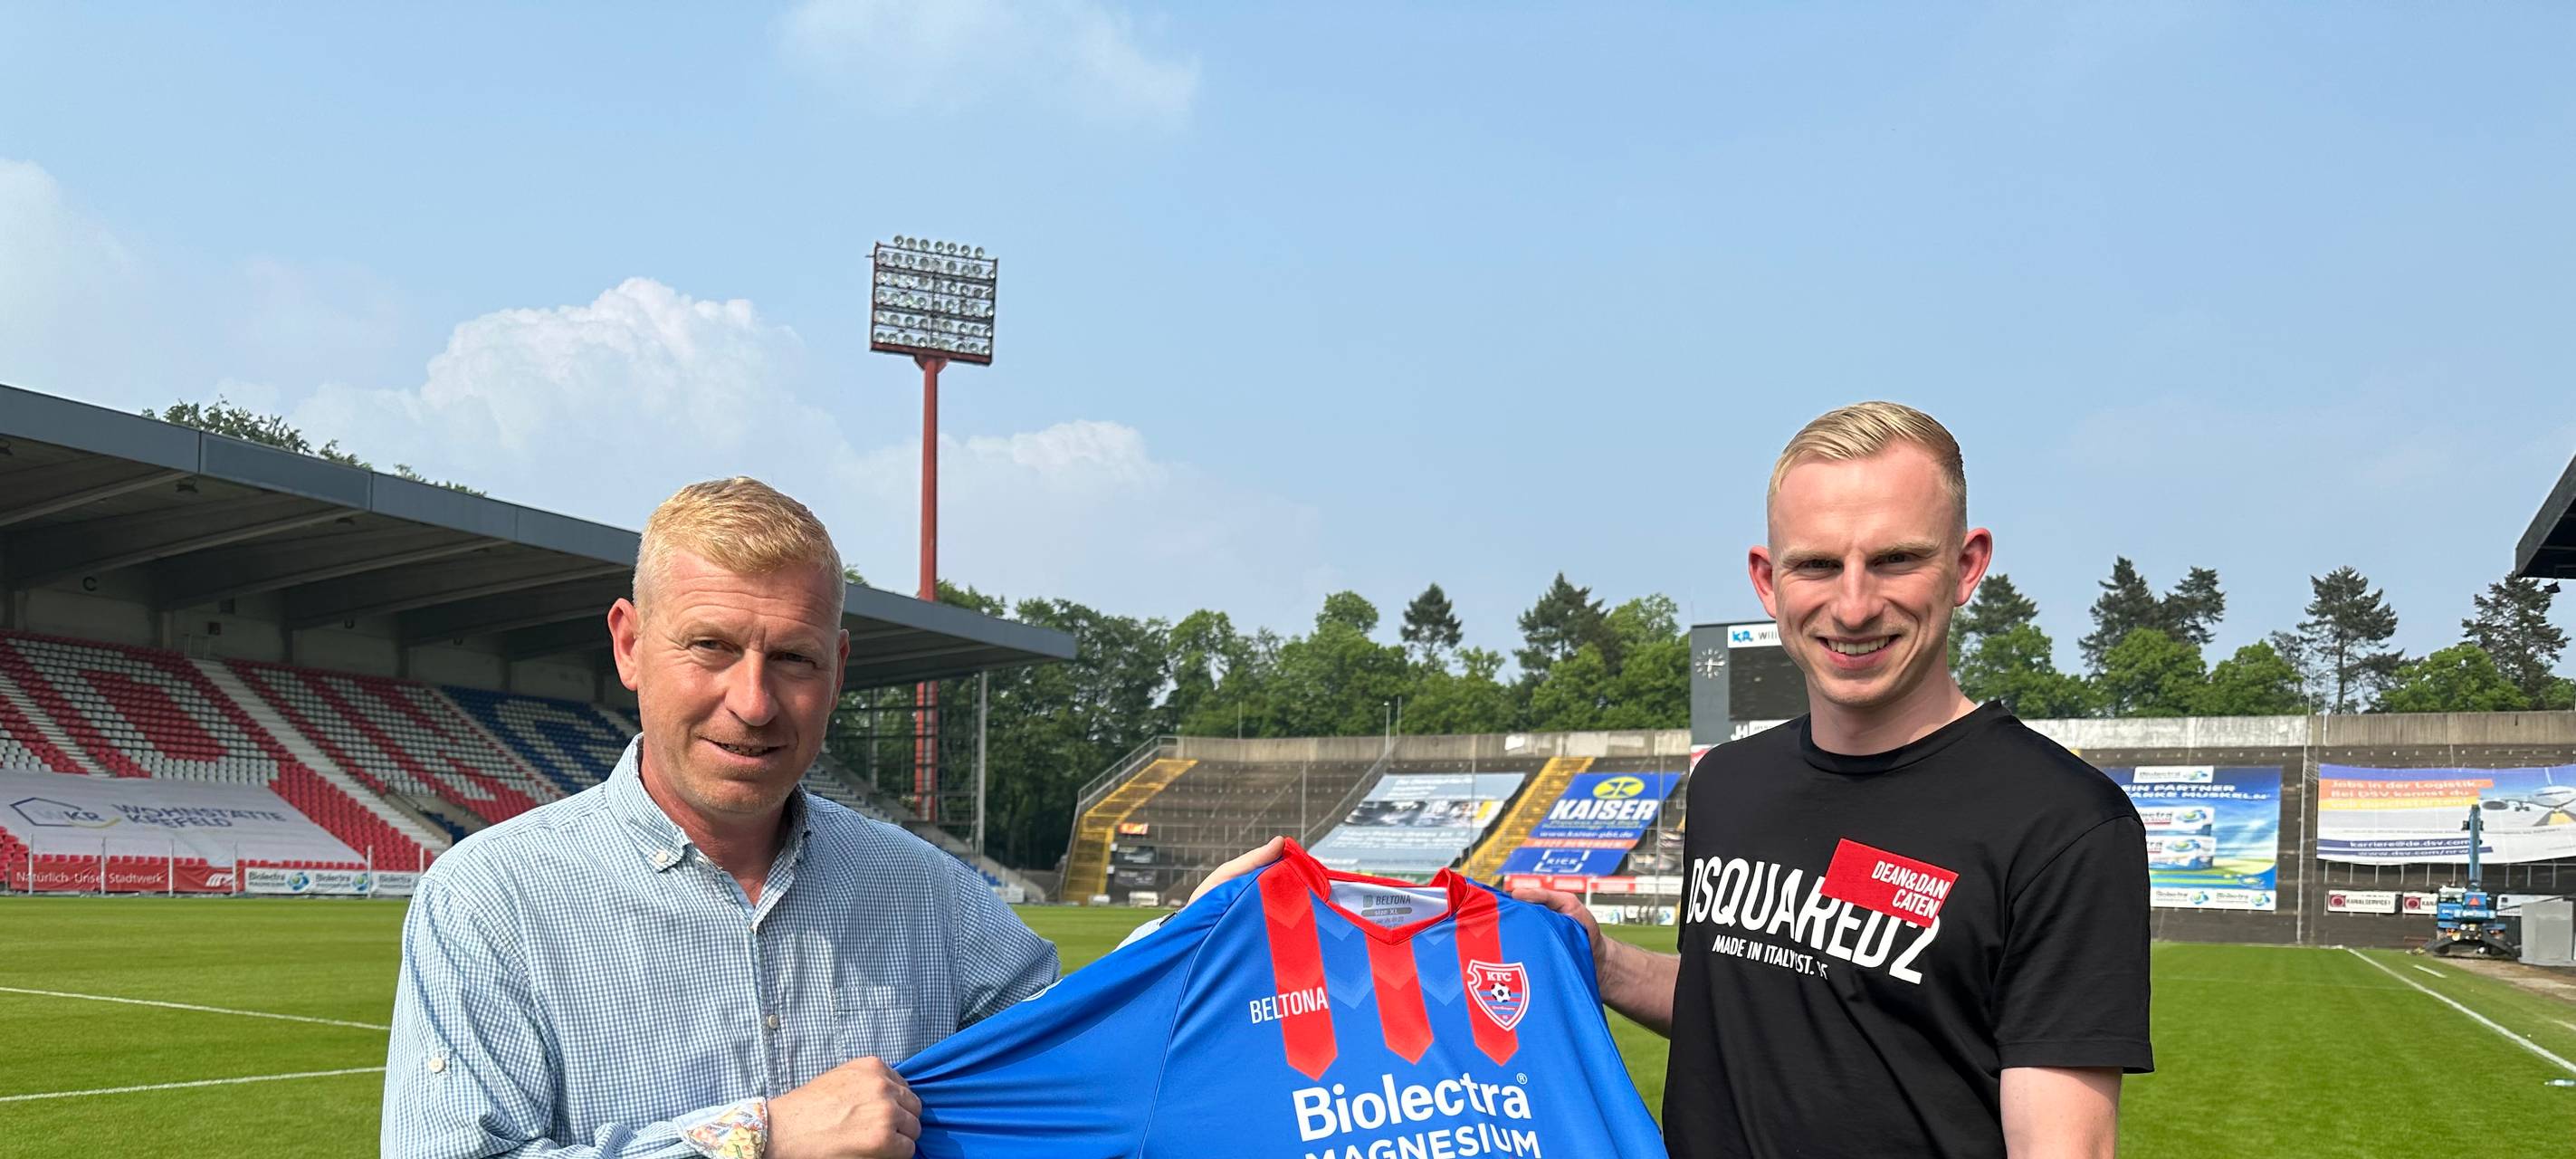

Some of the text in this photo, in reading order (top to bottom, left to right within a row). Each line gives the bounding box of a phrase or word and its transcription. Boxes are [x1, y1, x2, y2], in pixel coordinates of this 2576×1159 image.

[2331, 781, 2364, 789] Jobs
[2369, 781, 2382, 789] in
[2390, 781, 2409, 789] der
[2393, 790, 2444, 798] kannst
[1549, 799, 1659, 820] KAISER
[74, 872, 102, 884] Unse
[109, 873, 164, 884] Stadtwerk
[1870, 860, 1951, 900] DEAN&DAN
[1376, 895, 1411, 905] BELTONA
[1891, 888, 1940, 919] CATEN
[1712, 934, 1747, 957] MADE
[1746, 941, 1763, 961] IN
[1249, 987, 1329, 1024] BELTONA
[1304, 1123, 1541, 1159] GNESIUM
